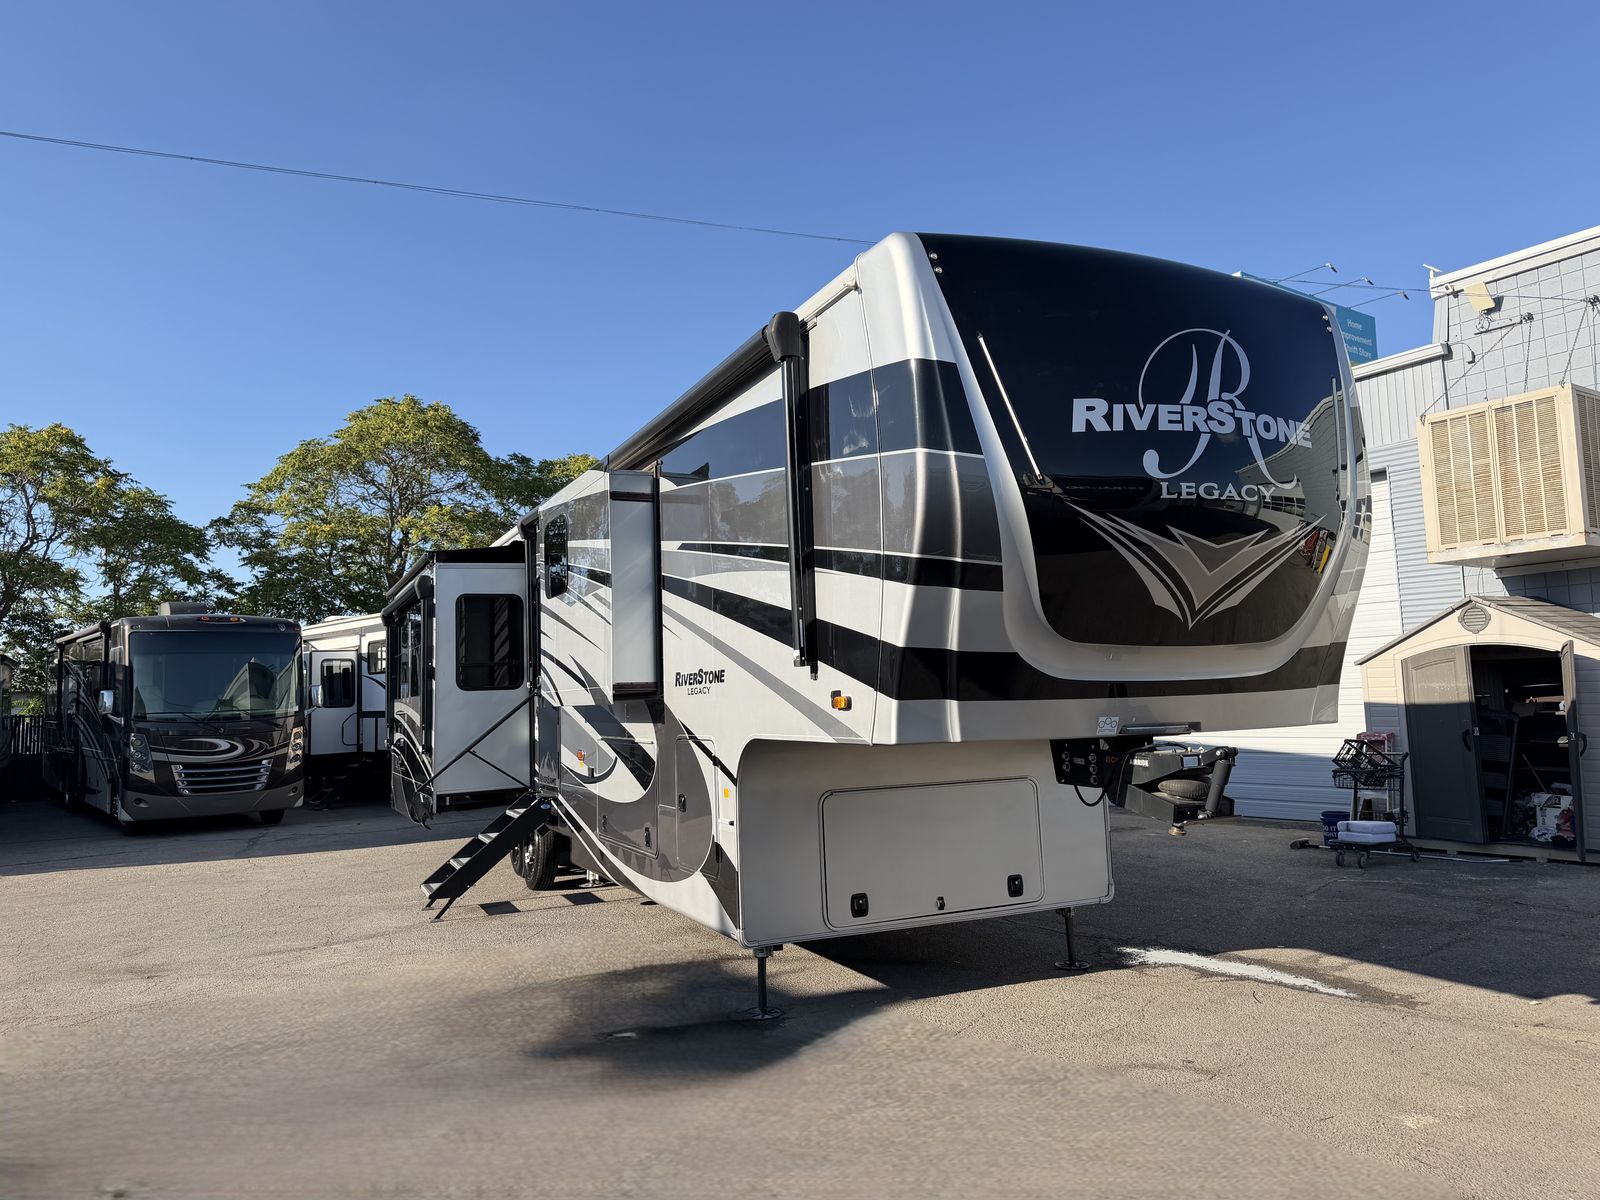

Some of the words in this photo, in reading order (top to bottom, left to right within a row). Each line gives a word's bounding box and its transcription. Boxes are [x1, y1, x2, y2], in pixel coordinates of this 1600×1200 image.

[1347, 319, 1362, 330] Home
[1342, 332, 1372, 345] mprovement
[1160, 482, 1276, 502] LEGACY
[687, 686, 711, 696] LEGACY
